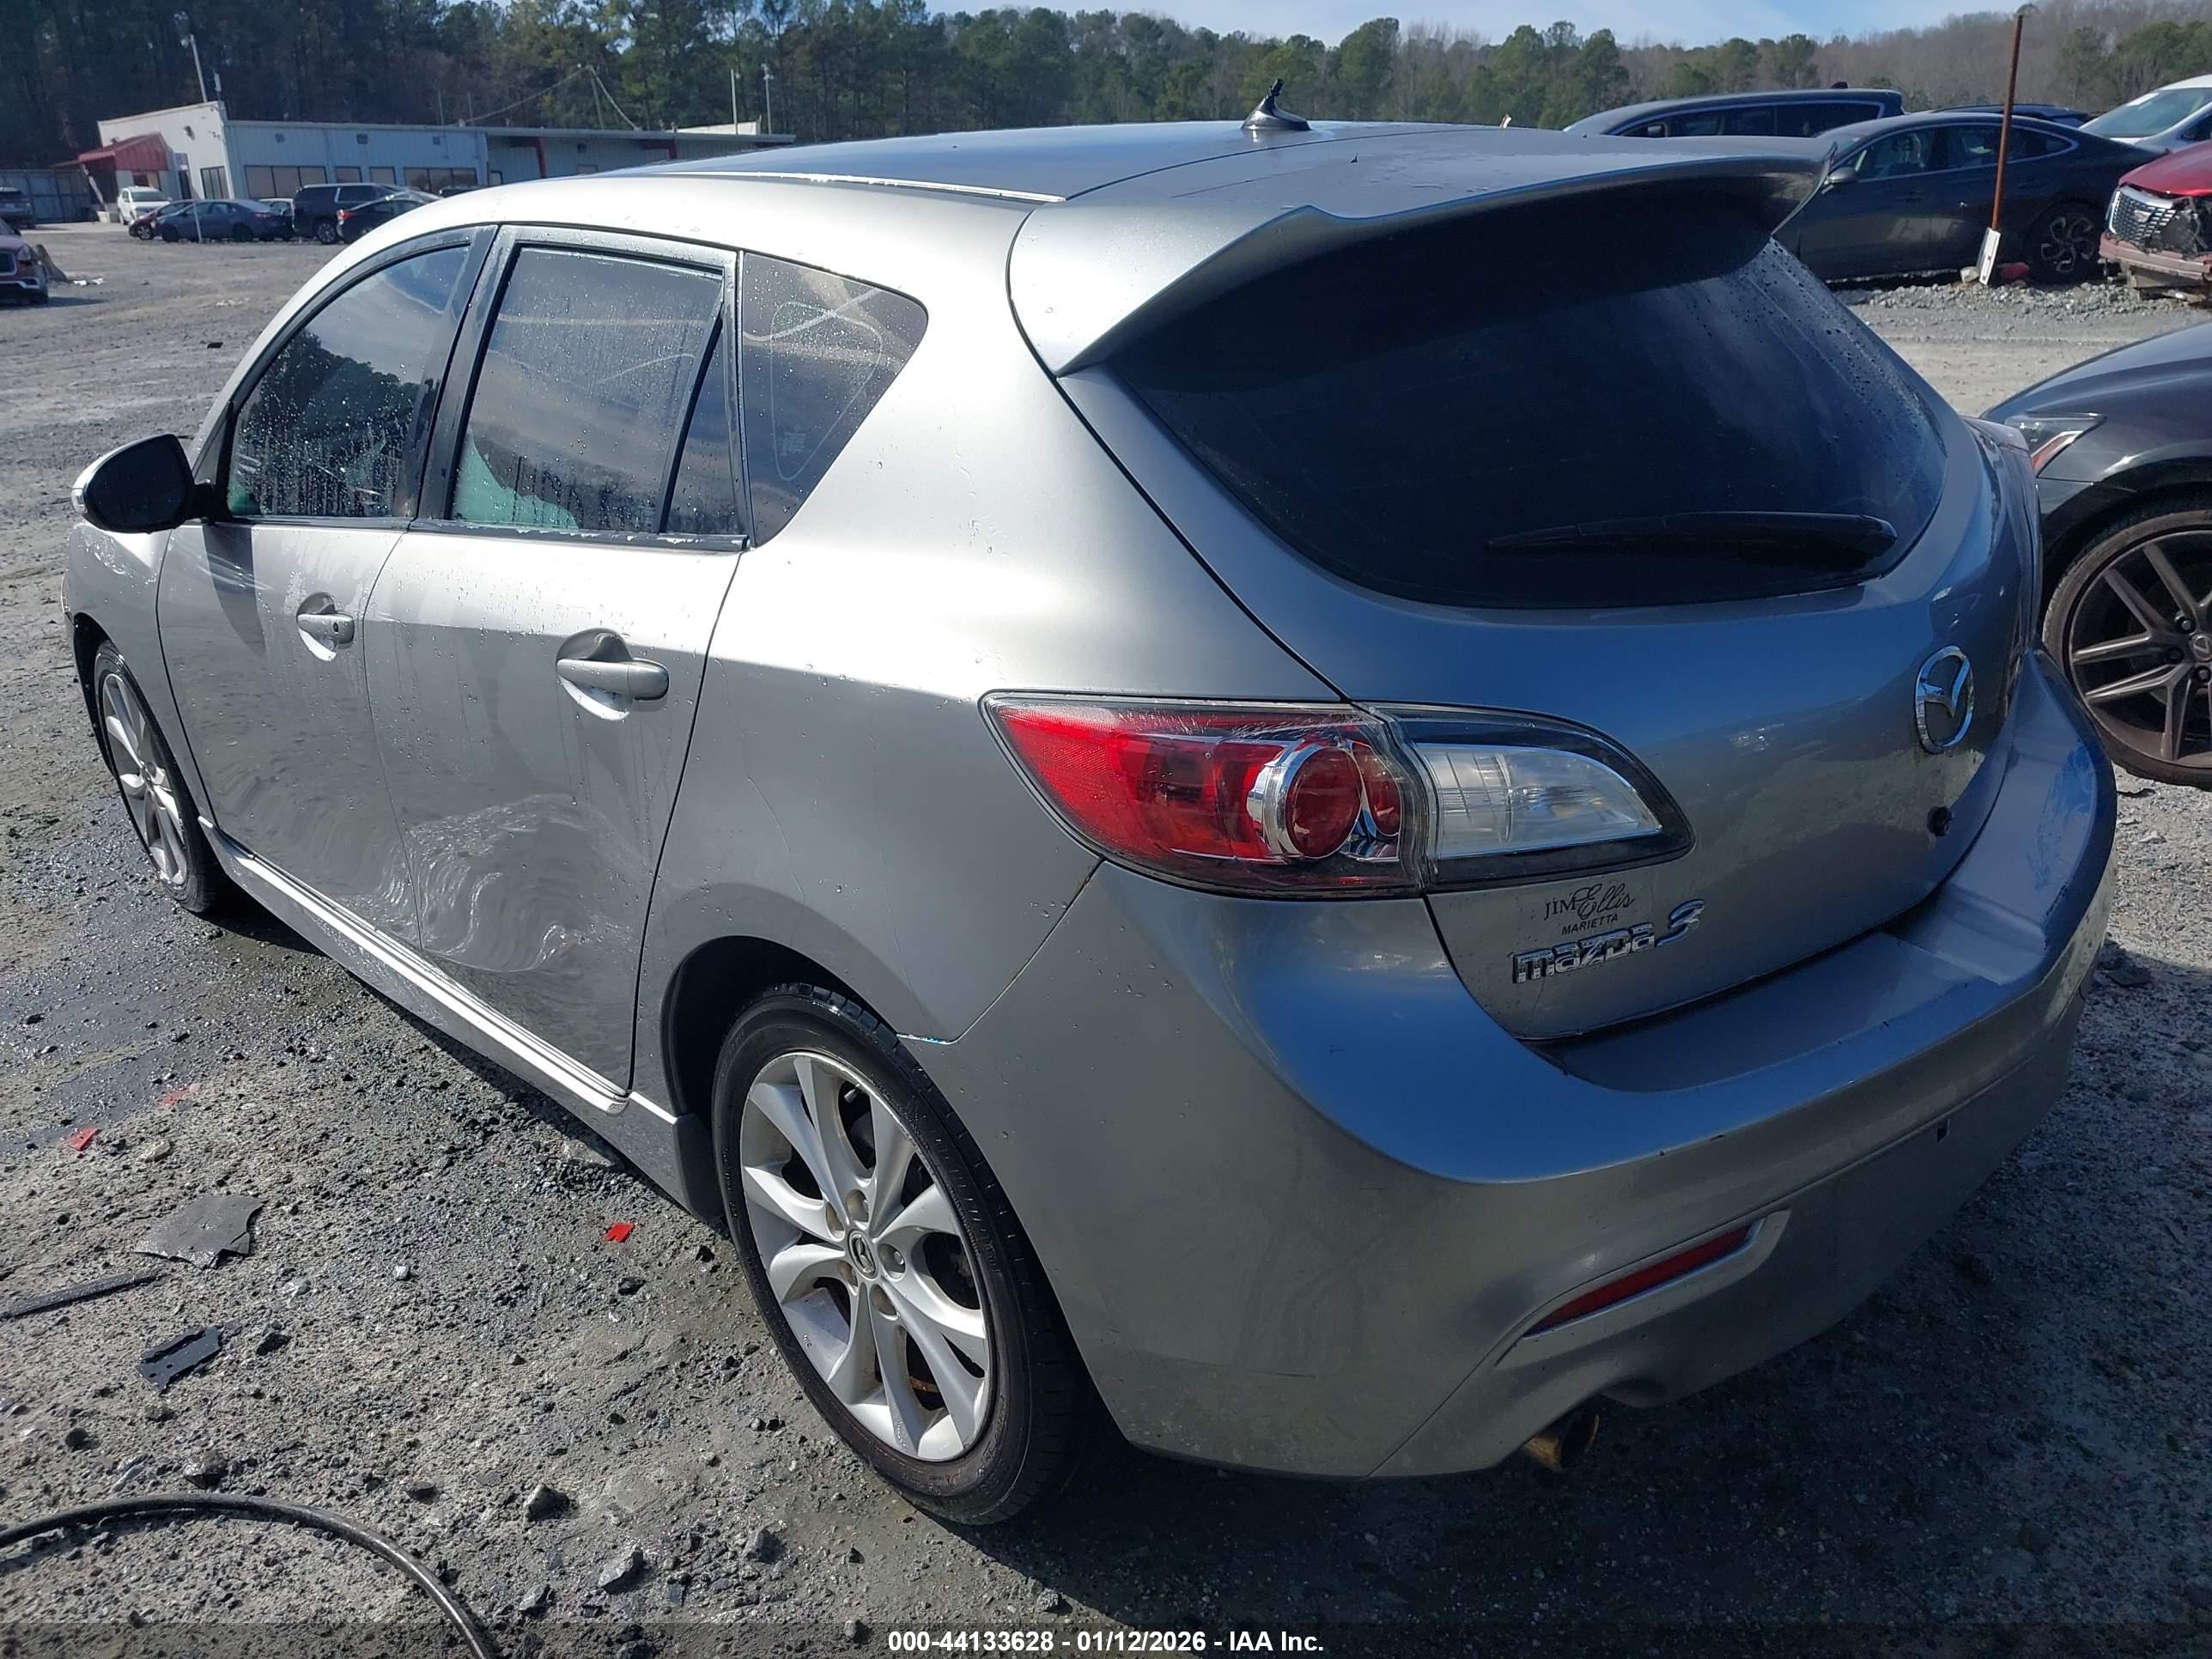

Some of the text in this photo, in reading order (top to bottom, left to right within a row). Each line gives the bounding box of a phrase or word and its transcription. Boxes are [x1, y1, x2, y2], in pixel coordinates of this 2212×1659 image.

[1544, 883, 1636, 921] JIM Ellis
[1561, 913, 1619, 935] MARIETTA
